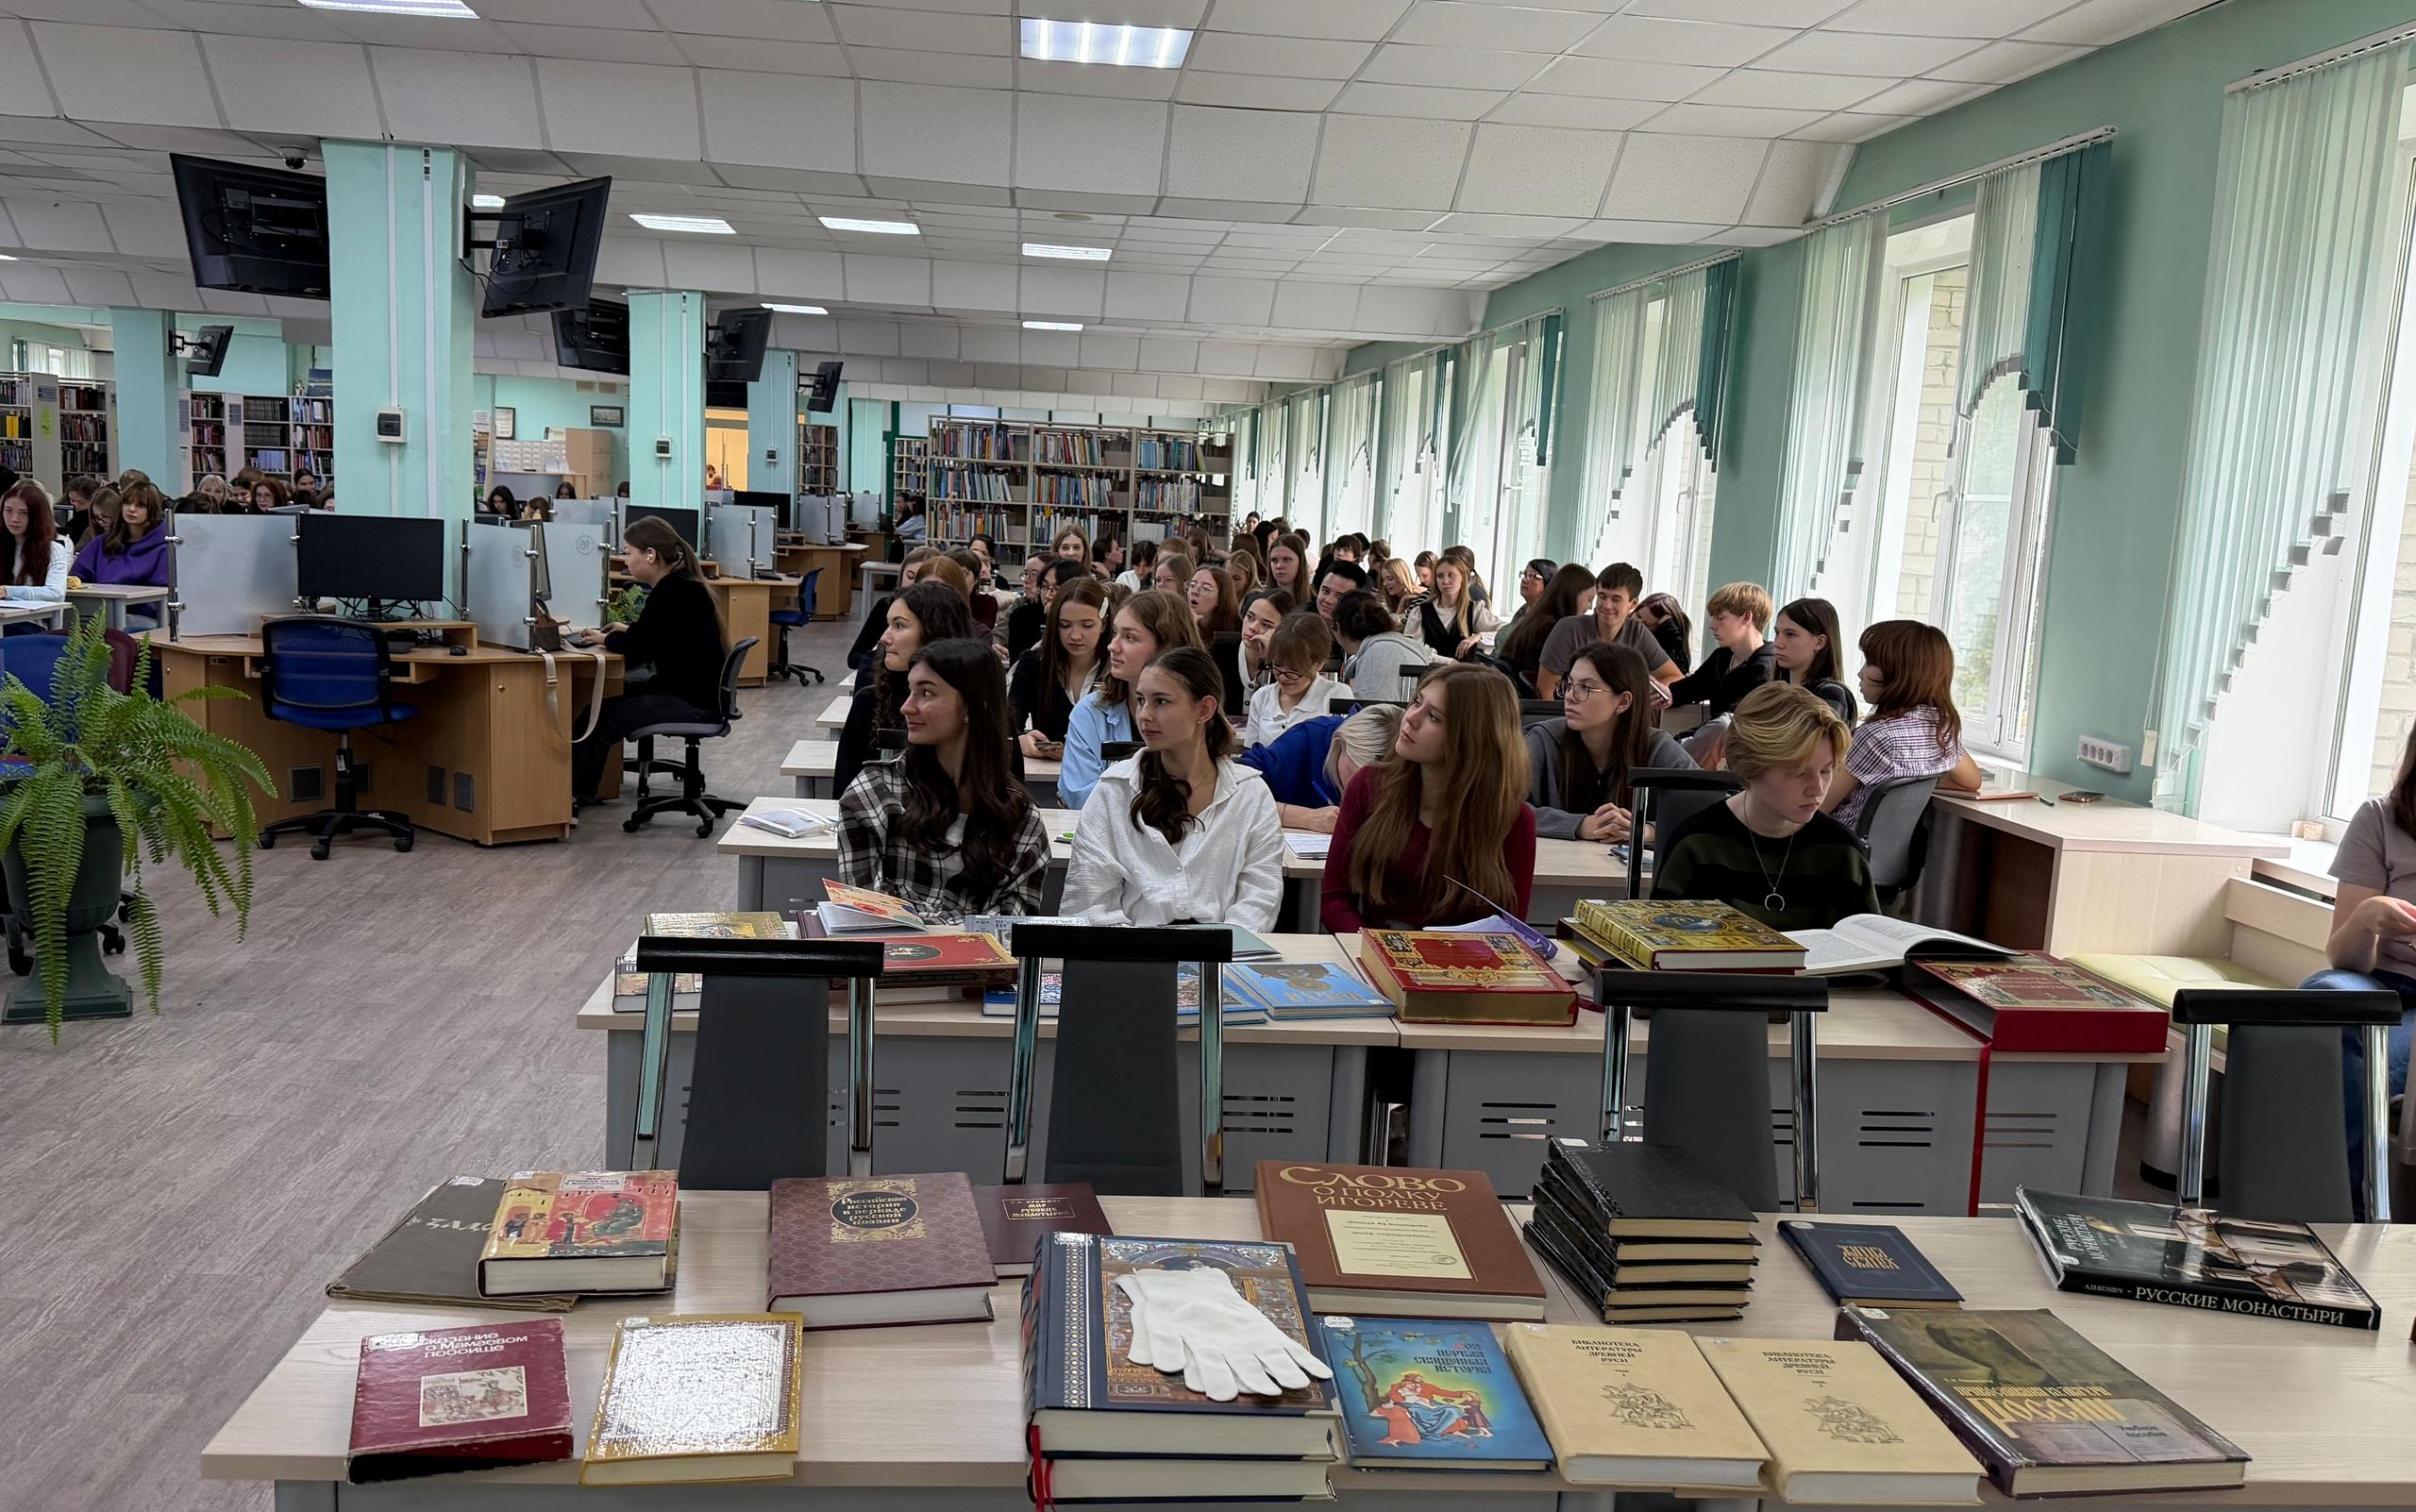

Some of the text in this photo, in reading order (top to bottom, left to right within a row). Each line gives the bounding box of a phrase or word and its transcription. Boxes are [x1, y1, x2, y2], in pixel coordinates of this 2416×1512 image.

[1279, 1167, 1466, 1192] СЛОВО
[1313, 1186, 1441, 1201] О ПОЛКУ
[1316, 1195, 1448, 1211] ИГОРЕВЕ
[2135, 1286, 2219, 1310] РУССКИЕ
[2222, 1298, 2346, 1325] МОНАСТЫРИ
[440, 1336, 528, 1351] Мамаевом
[1571, 1339, 1640, 1348] БИБЛИОТЕКА
[1762, 1351, 1832, 1359] БИБЛИОТЕКА
